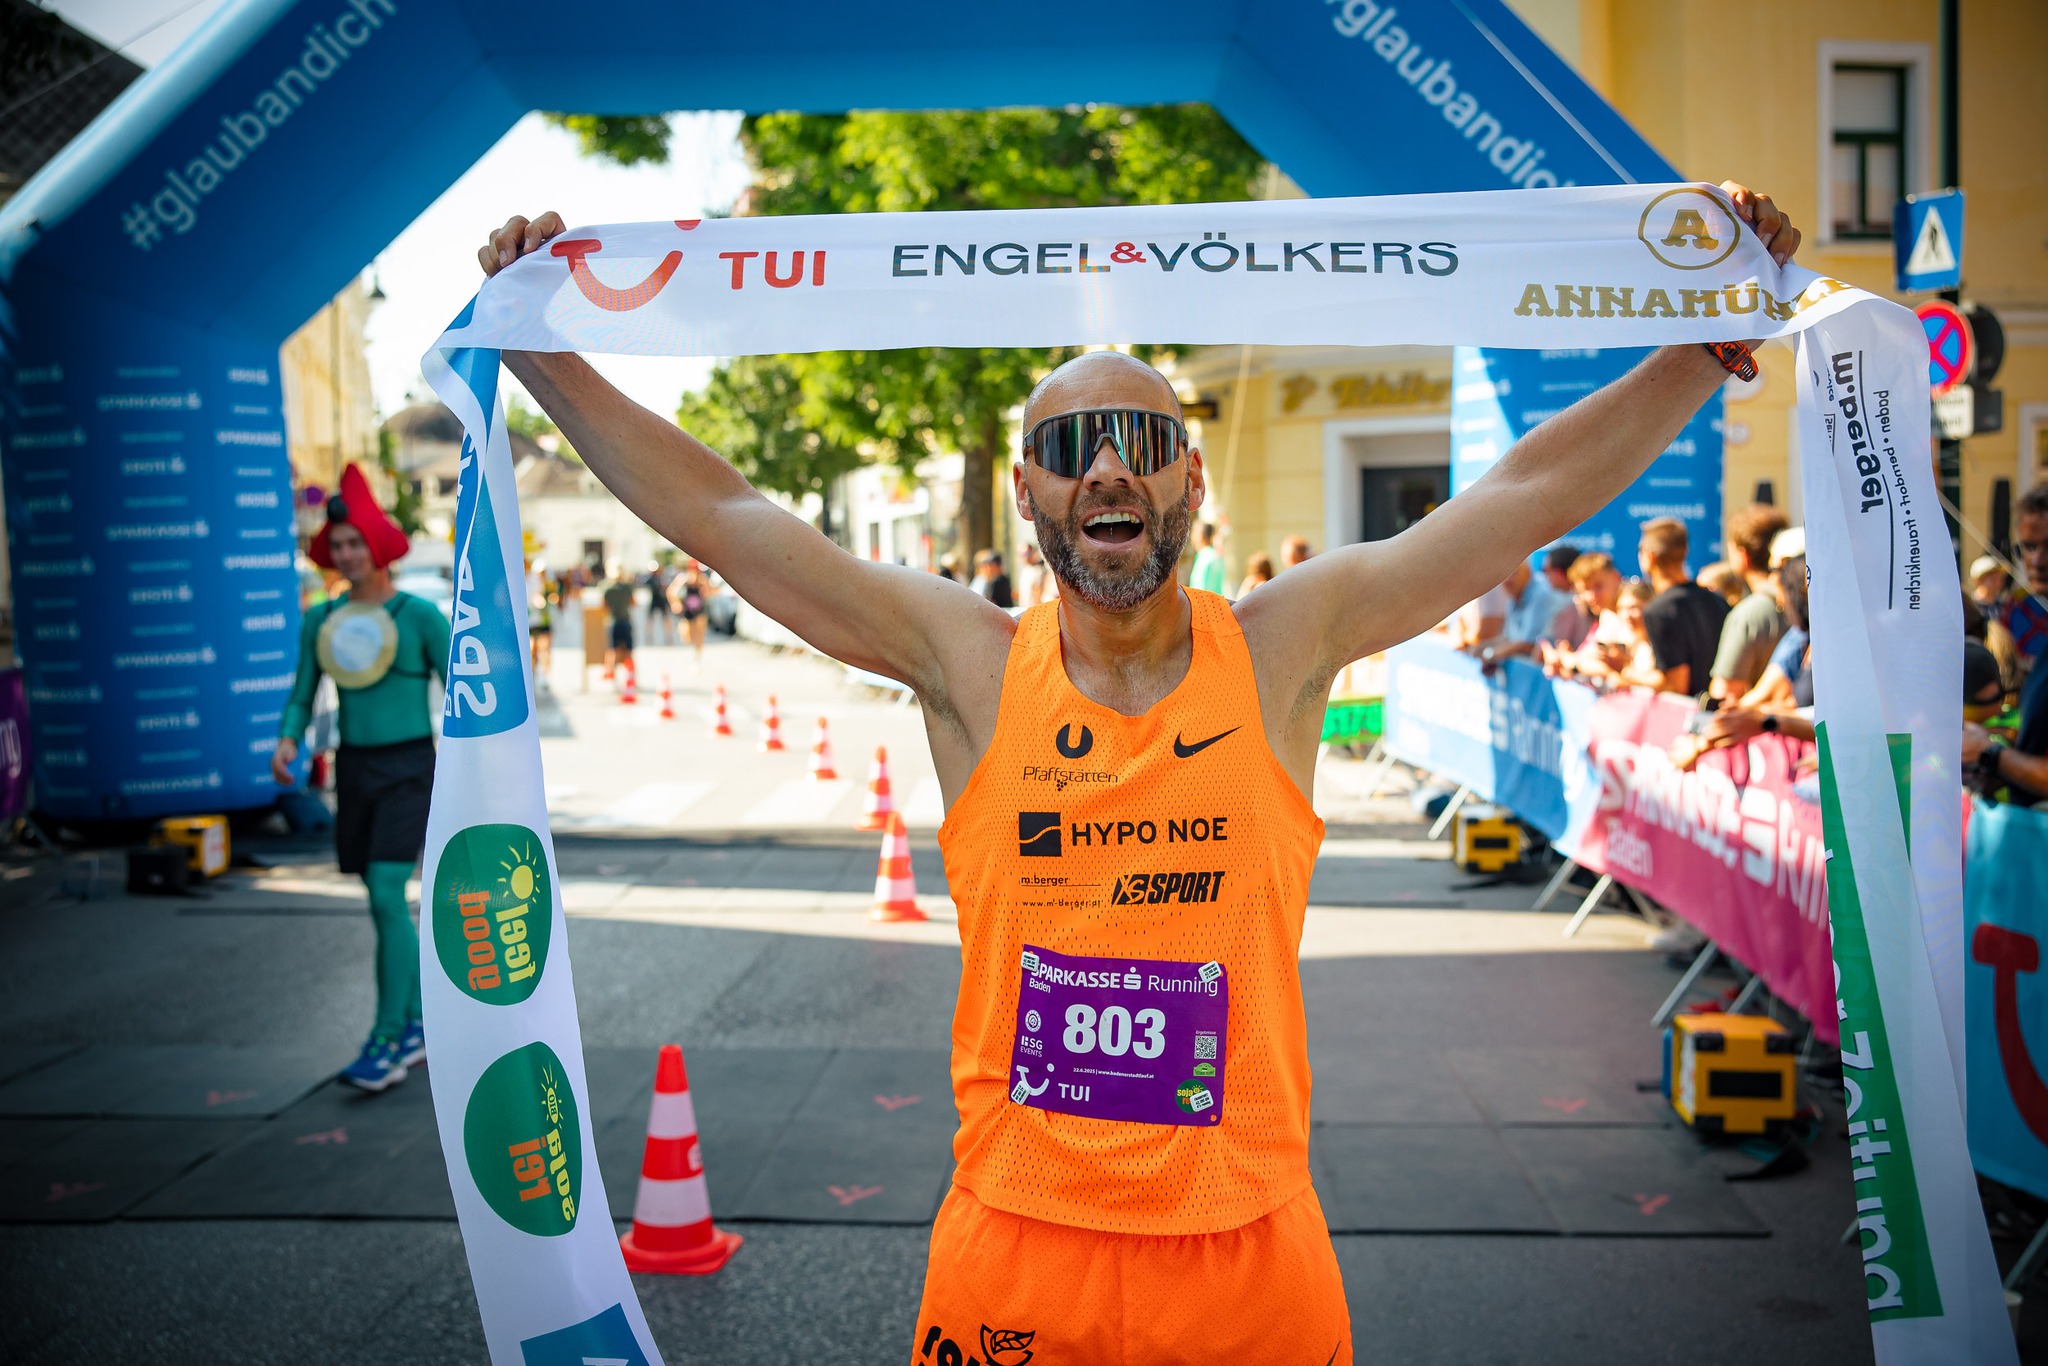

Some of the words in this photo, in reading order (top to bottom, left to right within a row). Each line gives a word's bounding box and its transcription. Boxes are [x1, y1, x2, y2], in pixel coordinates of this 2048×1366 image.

[121, 0, 399, 252] #glaubandich
[892, 232, 1459, 277] ENGEL&VÖLKERS
[719, 249, 826, 290] TUI
[1022, 765, 1119, 784] Pfaffstätten
[1071, 820, 1157, 846] HYPO
[1168, 817, 1228, 843] NOE
[1021, 874, 1069, 887] m.berger
[1148, 871, 1226, 905] SPORT
[1028, 977, 1051, 993] Baden
[1148, 975, 1218, 997] Running
[1062, 1003, 1166, 1059] 803
[1020, 1045, 1043, 1058] EVENTS
[1057, 1082, 1091, 1102] TUI
